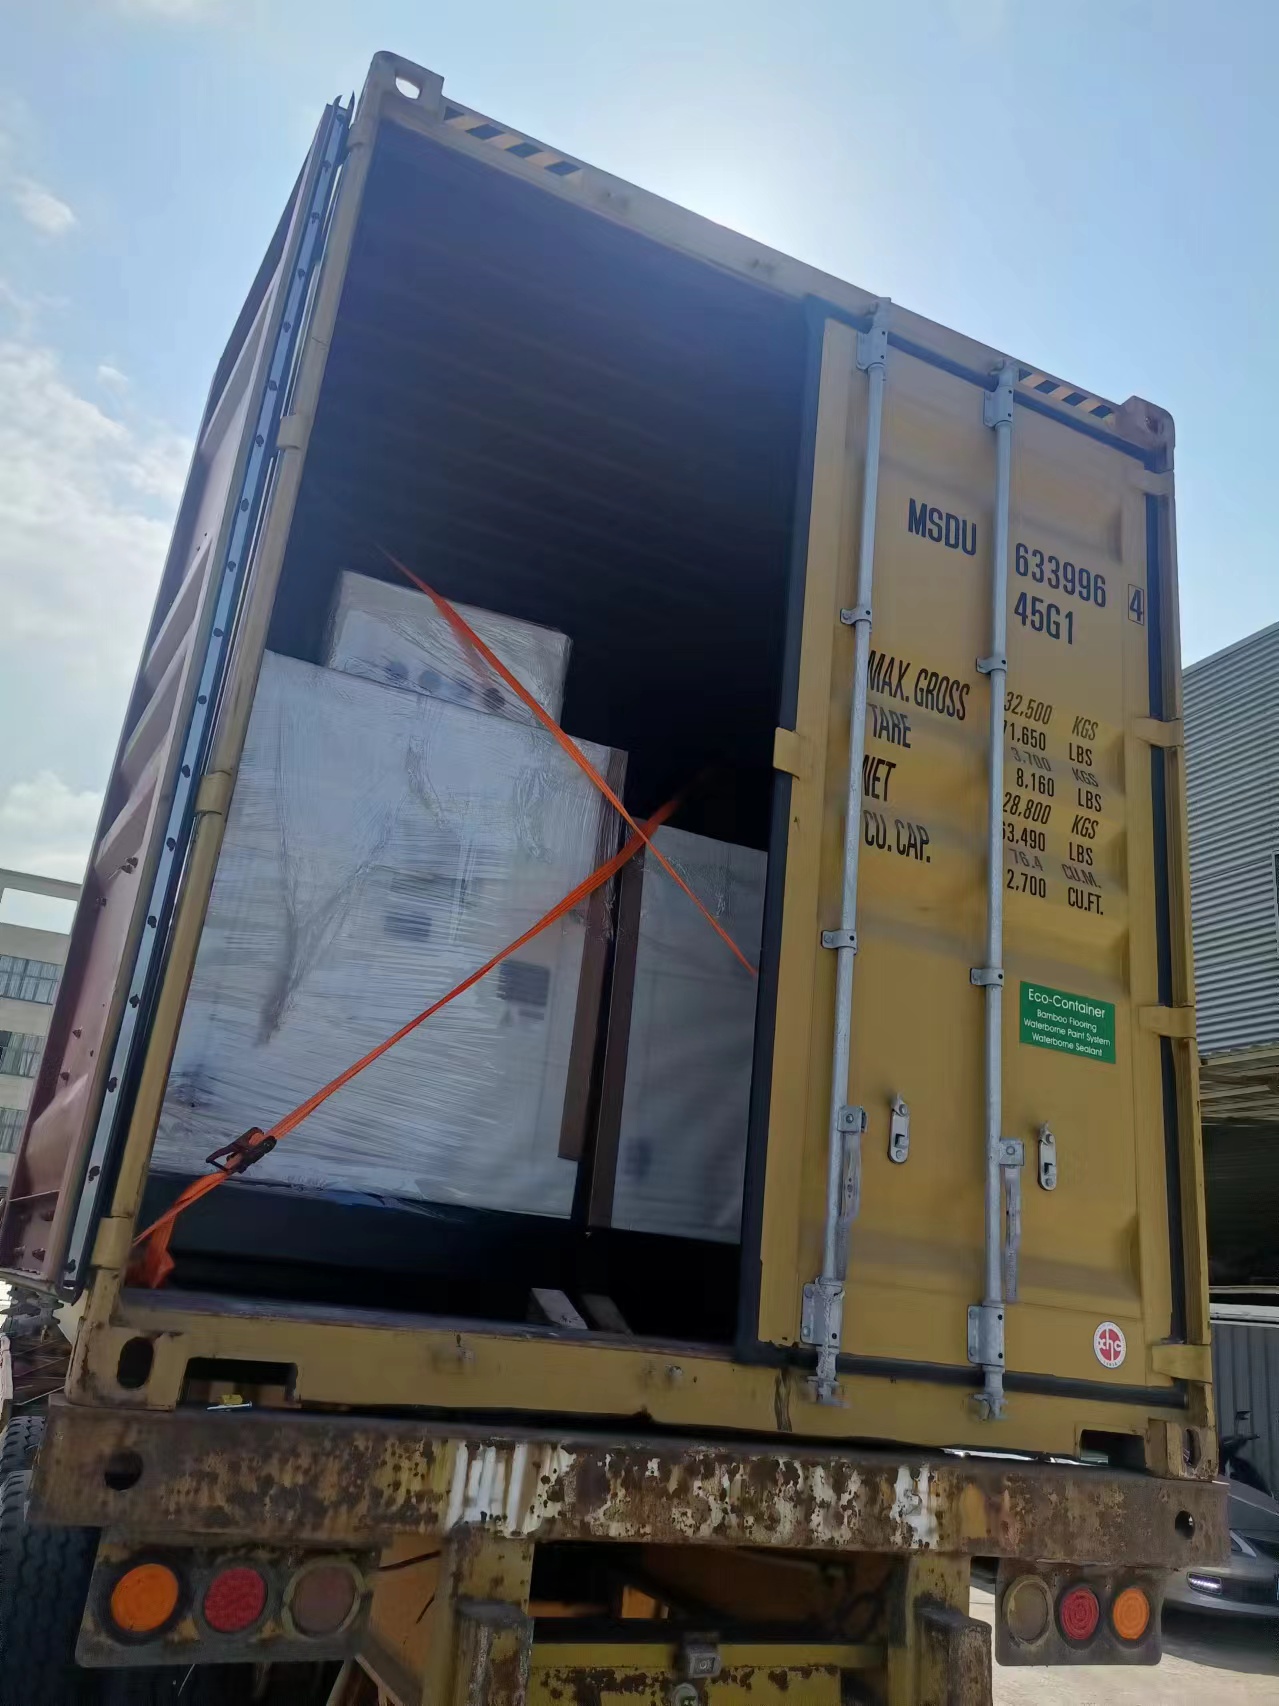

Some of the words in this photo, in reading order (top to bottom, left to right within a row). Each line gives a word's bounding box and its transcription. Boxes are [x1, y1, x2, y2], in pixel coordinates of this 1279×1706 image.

[908, 497, 977, 556] MSDU
[1015, 542, 1106, 608] 633996
[1130, 589, 1144, 622] 4
[1014, 591, 1074, 645] 45G1
[866, 650, 911, 703] MAX.
[914, 668, 970, 721] GROSS
[868, 703, 912, 749] TARE
[1003, 691, 1053, 726] 32,500
[1071, 715, 1099, 741] KGS
[1068, 742, 1093, 767] LBS
[1071, 766, 1099, 788] KGS
[1002, 792, 1052, 825] 28,800
[1071, 814, 1099, 840] KGS
[1077, 787, 1102, 813] LBS
[863, 809, 892, 853] CU.
[895, 819, 931, 863] CAP.
[1068, 842, 1094, 867] LBS
[1006, 868, 1047, 899] 2,700
[1067, 886, 1104, 916] CU.FT.
[1028, 988, 1106, 1018] Eco-Container
[1036, 1008, 1068, 1024] Bamboo
[1069, 1016, 1097, 1033] Flooring
[1023, 1017, 1066, 1036] Waterborne
[1067, 1028, 1085, 1040] Paint
[1086, 1032, 1111, 1047] System
[1031, 1031, 1074, 1050] Waterborne
[1075, 1042, 1103, 1057] Sealant
